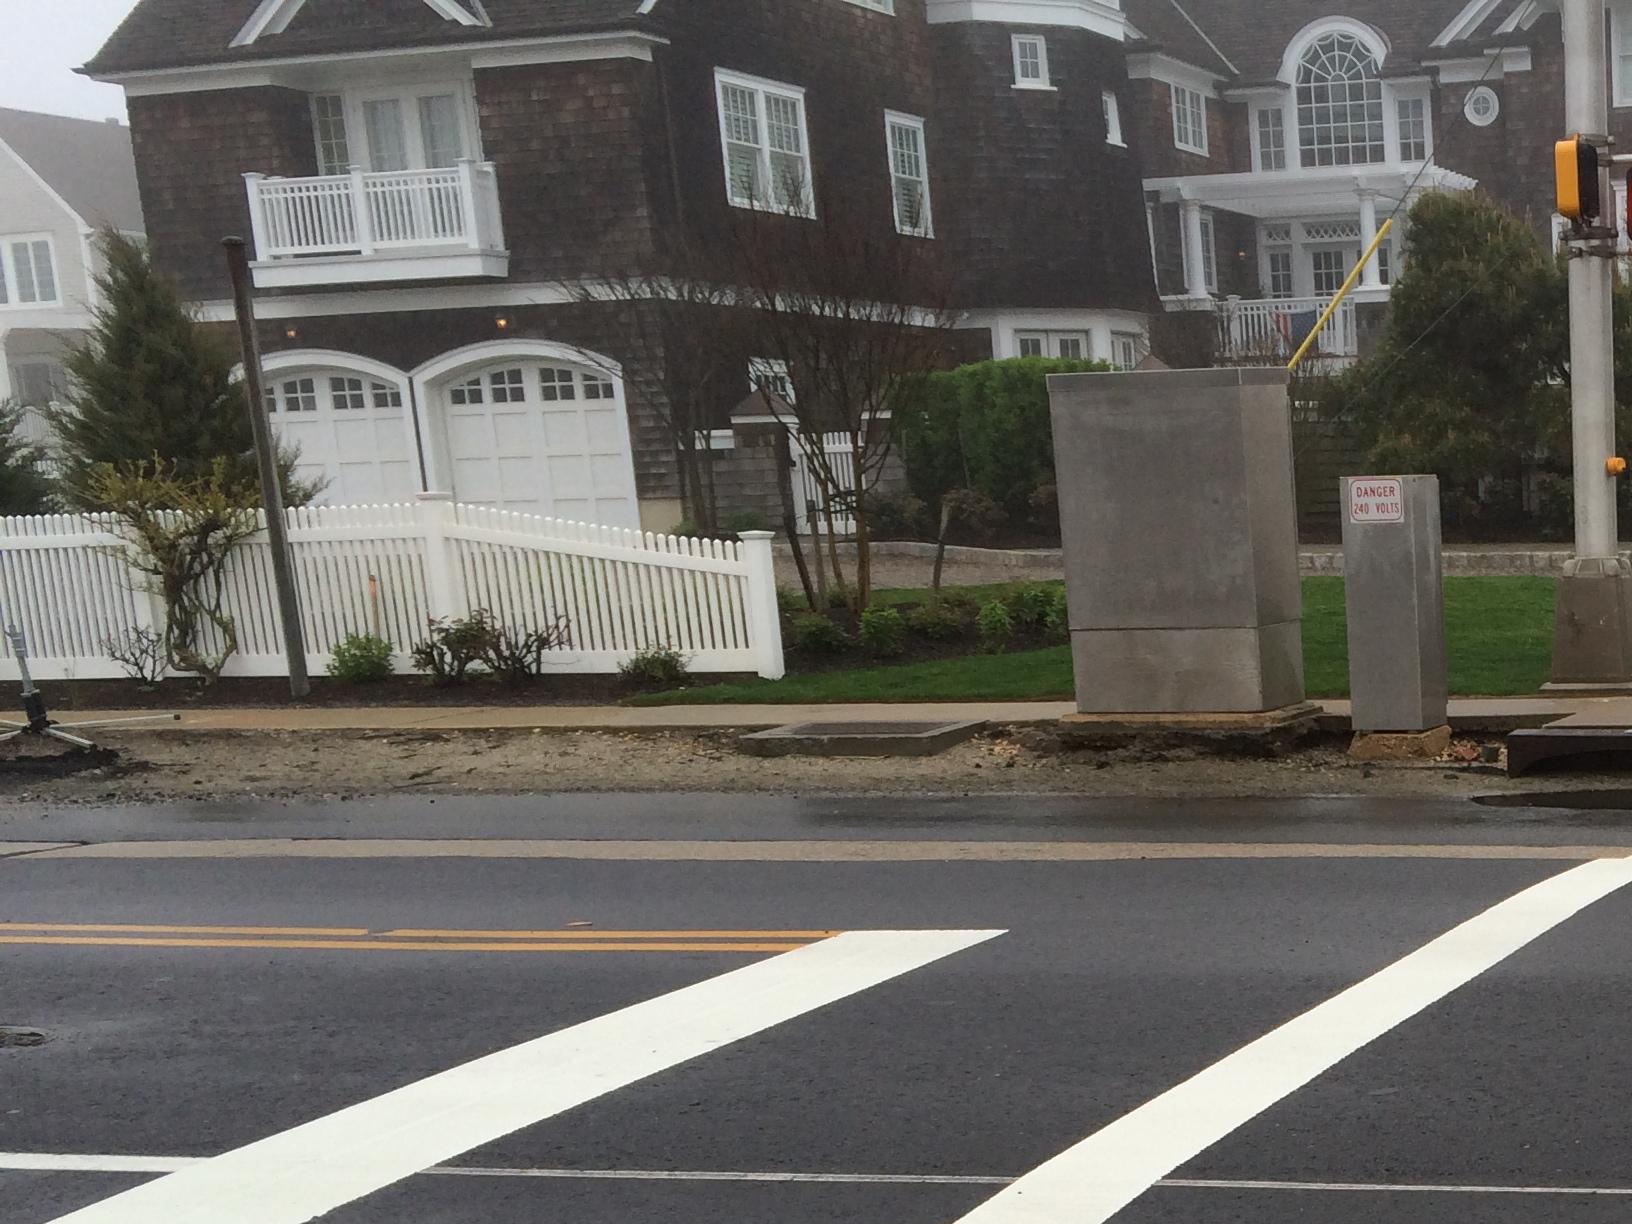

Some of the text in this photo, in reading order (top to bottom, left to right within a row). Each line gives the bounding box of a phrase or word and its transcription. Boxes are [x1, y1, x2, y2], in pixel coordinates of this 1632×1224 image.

[1356, 486, 1395, 498] DANGER
[1353, 502, 1400, 514] 240 VOLTS
